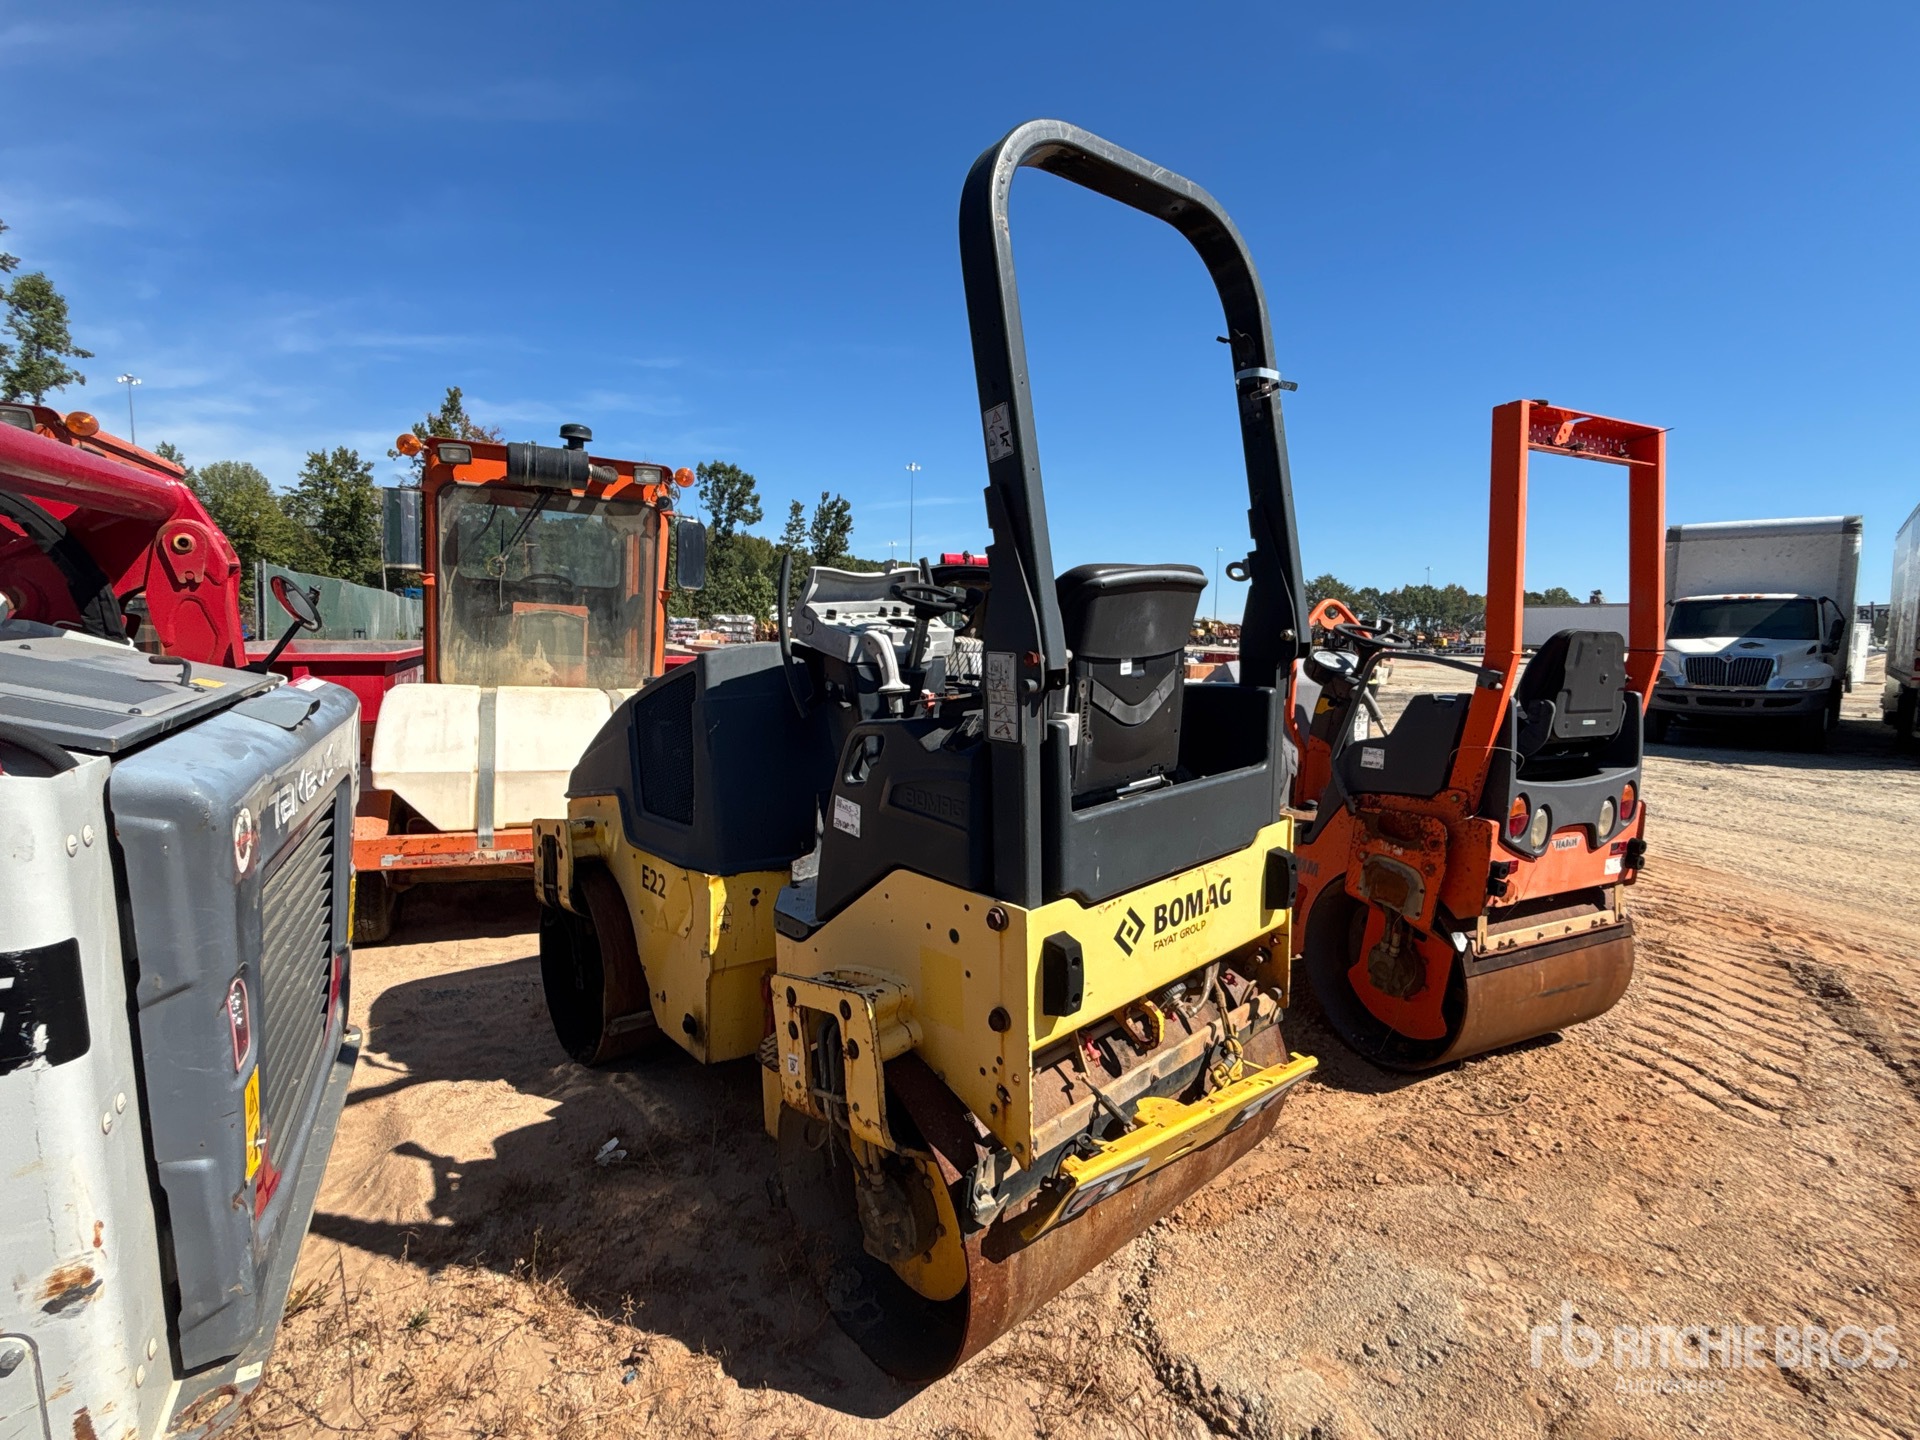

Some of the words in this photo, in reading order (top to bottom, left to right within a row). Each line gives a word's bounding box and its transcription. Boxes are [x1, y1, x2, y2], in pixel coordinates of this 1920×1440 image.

[642, 864, 666, 900] E22
[1154, 877, 1231, 936] BOMAG
[1153, 932, 1178, 952] FAYAT
